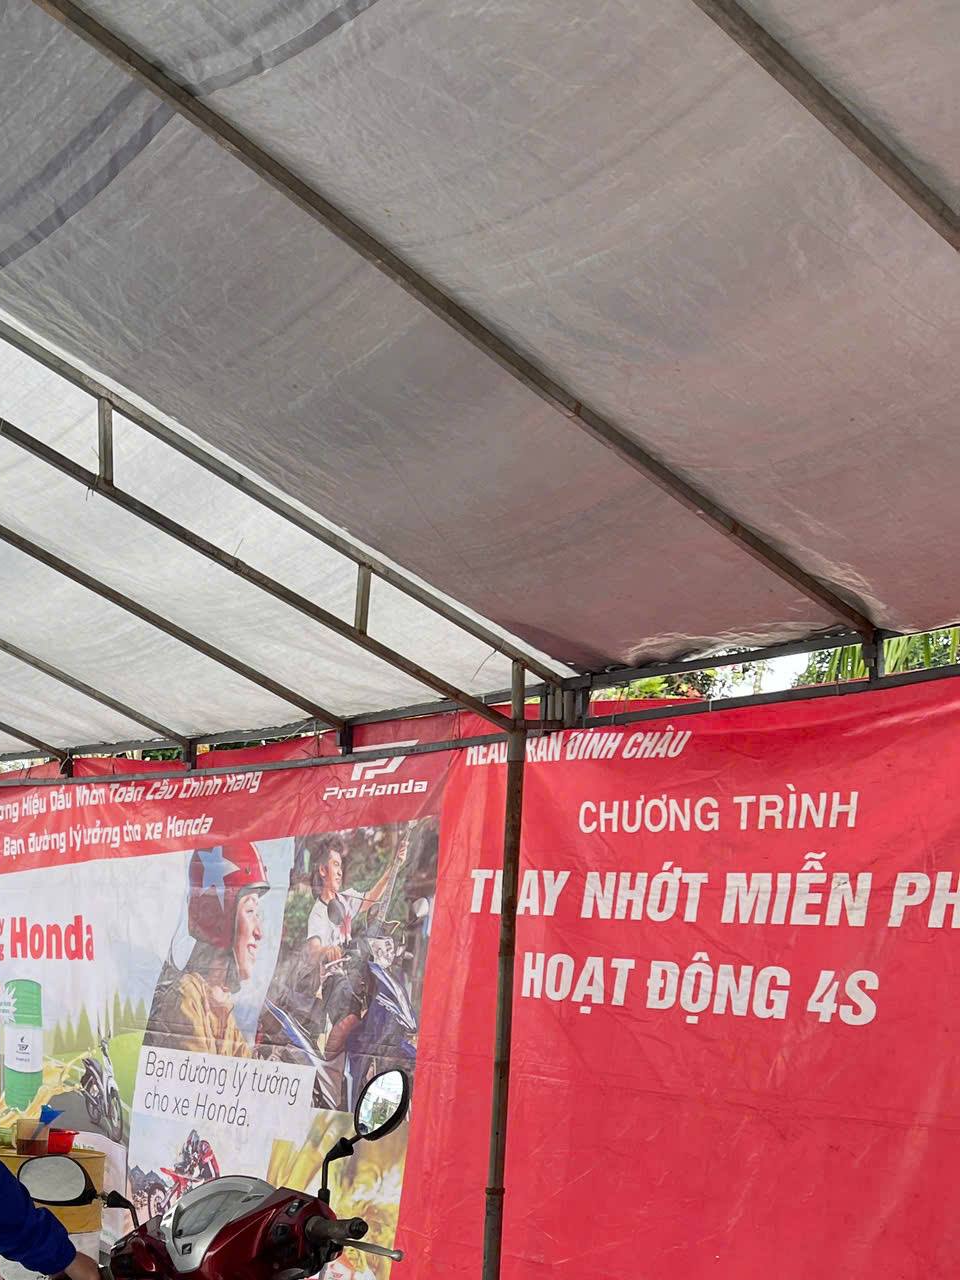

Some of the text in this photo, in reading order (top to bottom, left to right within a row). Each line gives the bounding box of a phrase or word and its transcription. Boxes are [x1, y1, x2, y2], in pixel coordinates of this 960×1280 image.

[622, 724, 692, 759] CHÂU
[22, 792, 46, 819] Hiệu
[579, 783, 859, 834] CHƯƠNG TRÌNH
[3, 836, 25, 860] Bạn
[28, 829, 66, 853] đường
[69, 824, 81, 851] lý
[123, 821, 141, 842] cho
[144, 821, 162, 840] xe
[166, 813, 214, 838] Honda
[580, 861, 709, 923] NHỚT
[721, 851, 873, 927] MIỄN
[10, 915, 95, 961] Honda
[520, 951, 880, 1027] HOẠT ĐỘNG 4S
[145, 1051, 300, 1106] Bạn đường lý tưởng
[144, 1086, 250, 1127] cho xe Honda.
